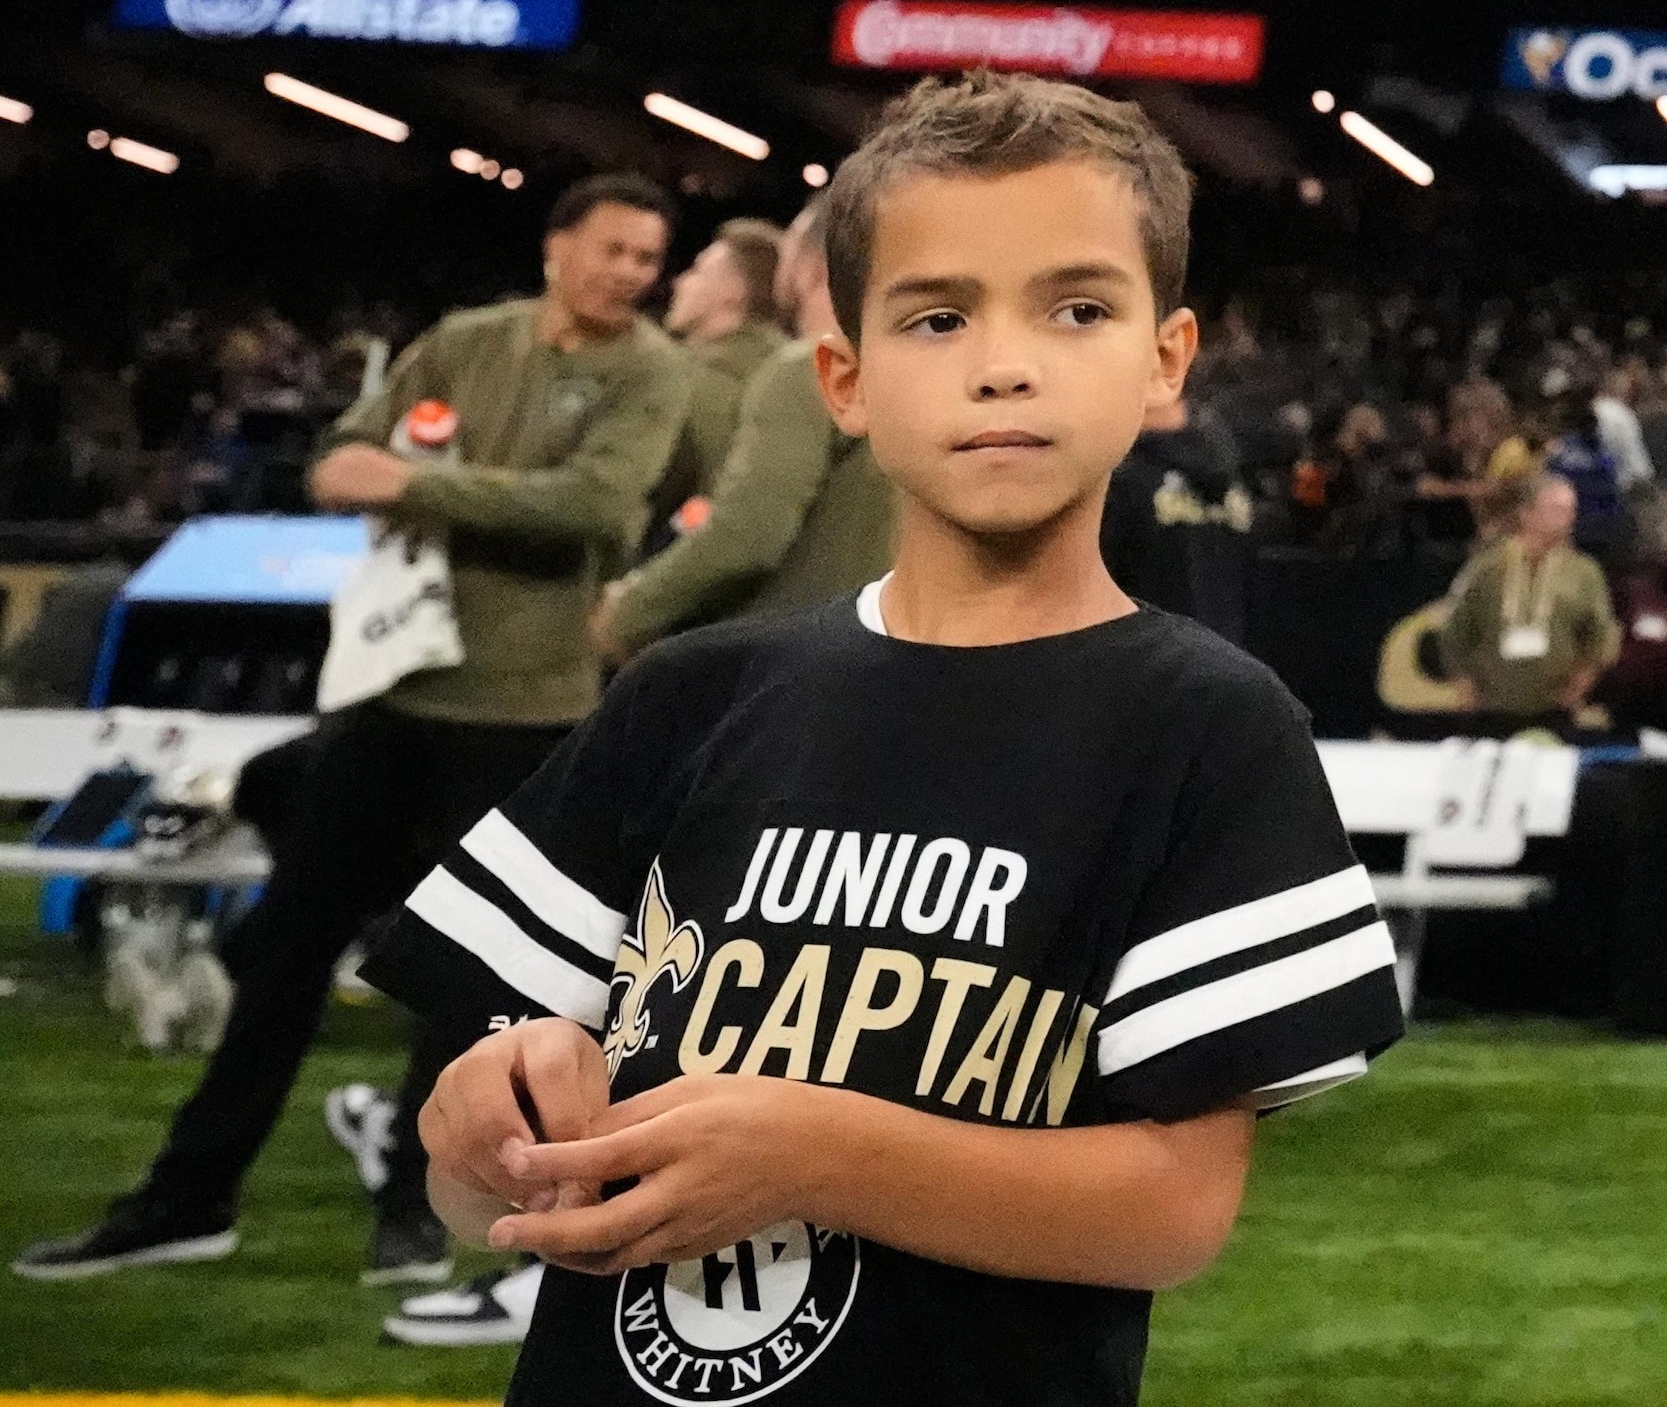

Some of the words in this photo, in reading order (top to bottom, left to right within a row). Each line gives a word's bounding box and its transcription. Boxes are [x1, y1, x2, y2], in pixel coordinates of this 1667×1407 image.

[724, 827, 1028, 948] JUNIOR
[677, 938, 1100, 1127] CAPTAIN
[624, 1287, 830, 1393] WHITNEY
